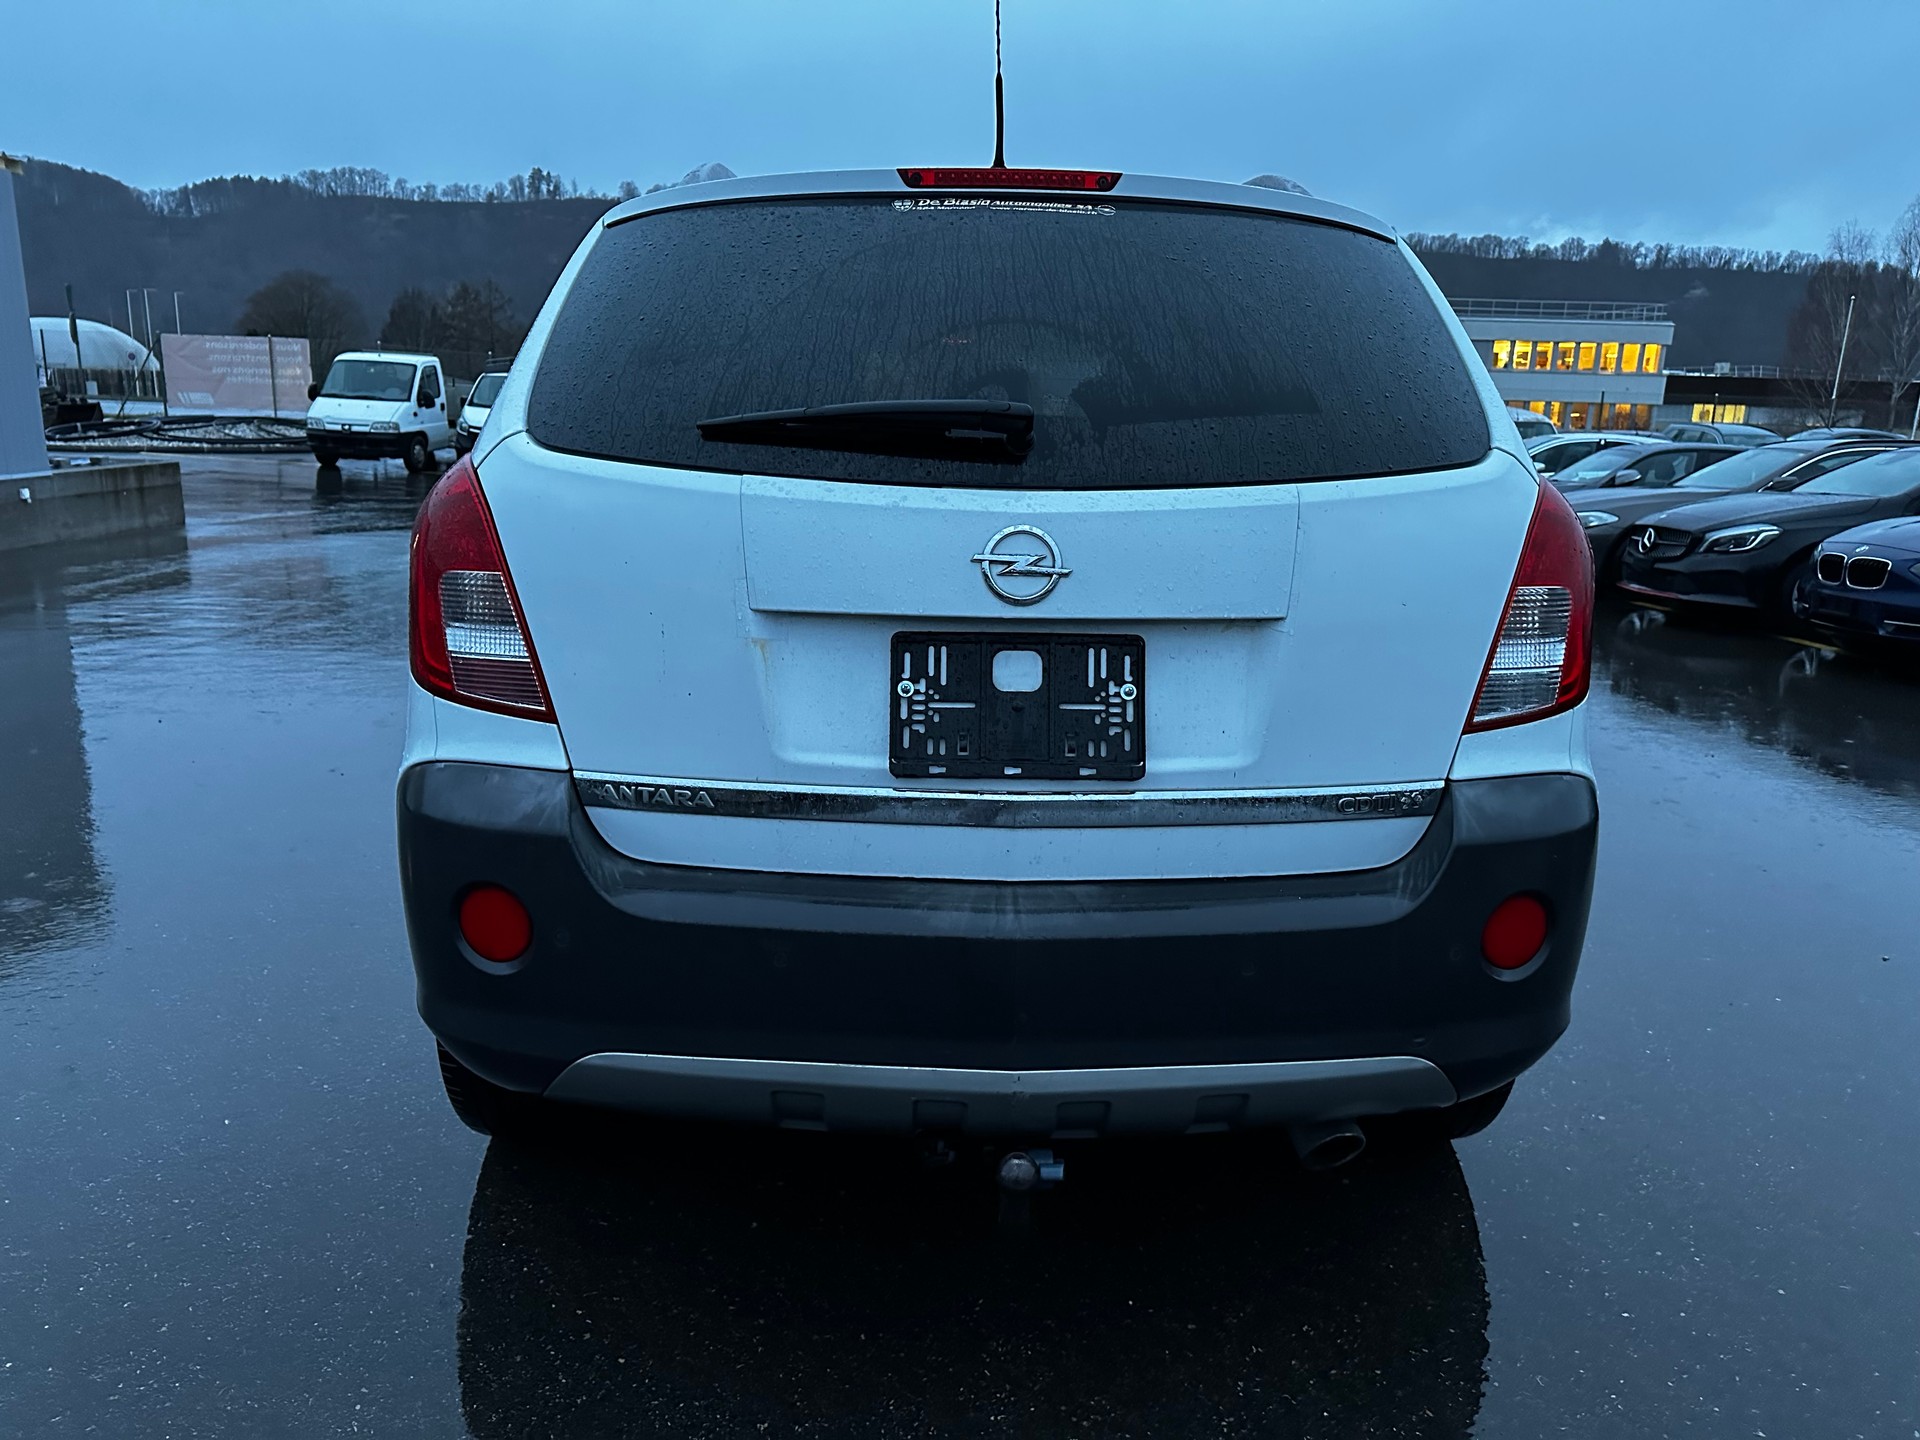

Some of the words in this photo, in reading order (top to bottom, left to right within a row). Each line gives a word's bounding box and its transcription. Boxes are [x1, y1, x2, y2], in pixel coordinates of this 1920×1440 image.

[916, 198, 940, 206] De
[941, 198, 990, 206] Blasio
[599, 784, 715, 809] ANTARA
